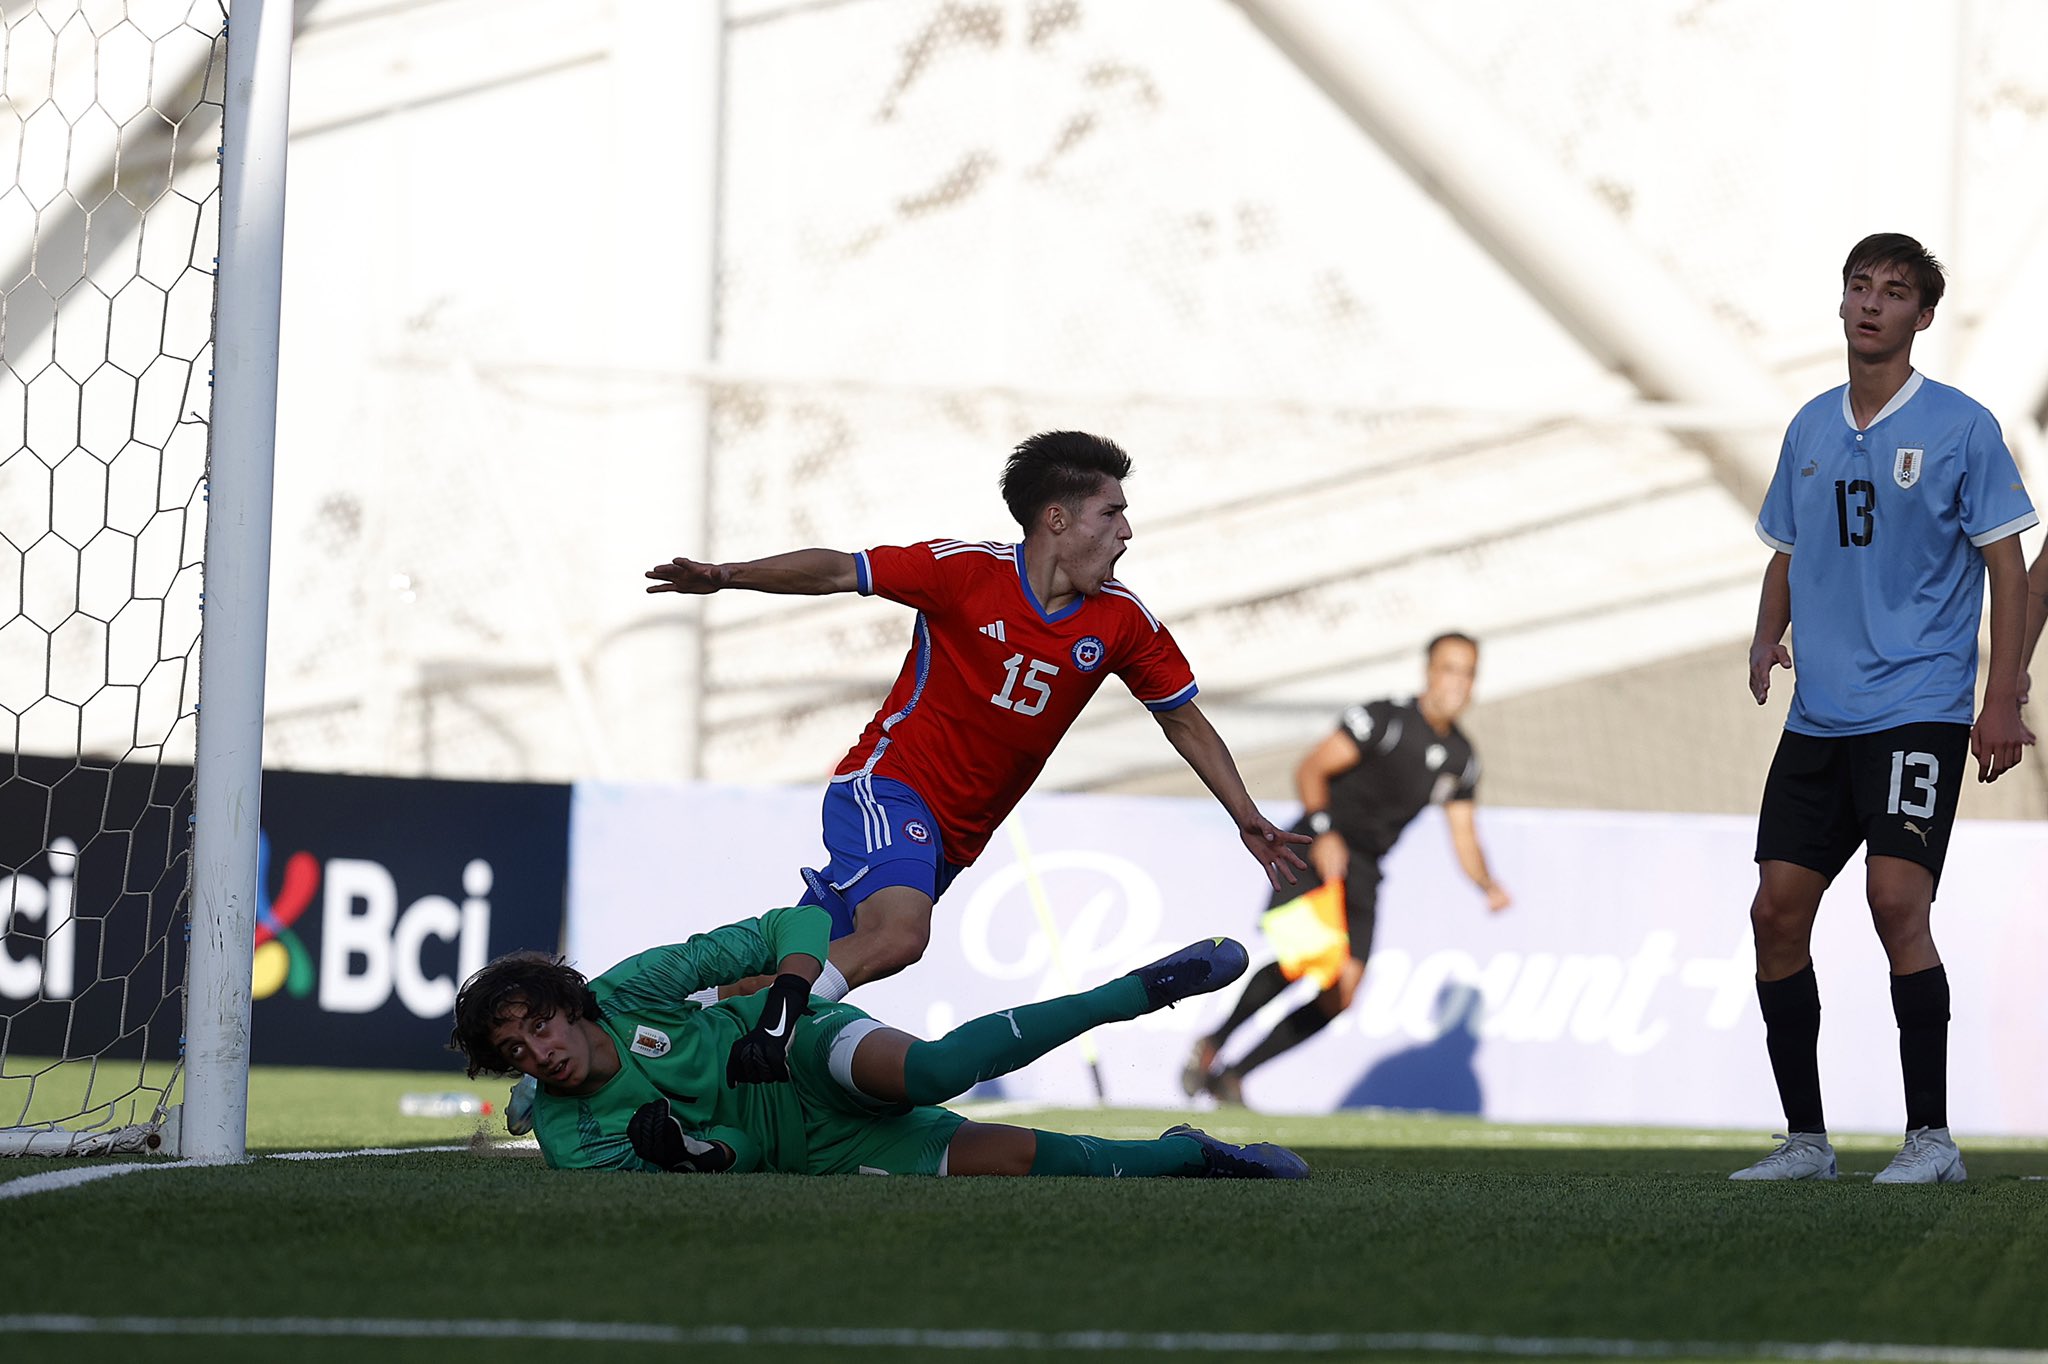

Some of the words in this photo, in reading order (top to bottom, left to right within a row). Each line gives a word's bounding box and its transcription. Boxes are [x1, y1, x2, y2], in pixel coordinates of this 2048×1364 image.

[1834, 479, 1875, 547] 13
[990, 652, 1060, 717] 15
[1887, 750, 1939, 819] 13
[318, 858, 494, 1019] Bci
[927, 849, 1756, 1055] Pount+
